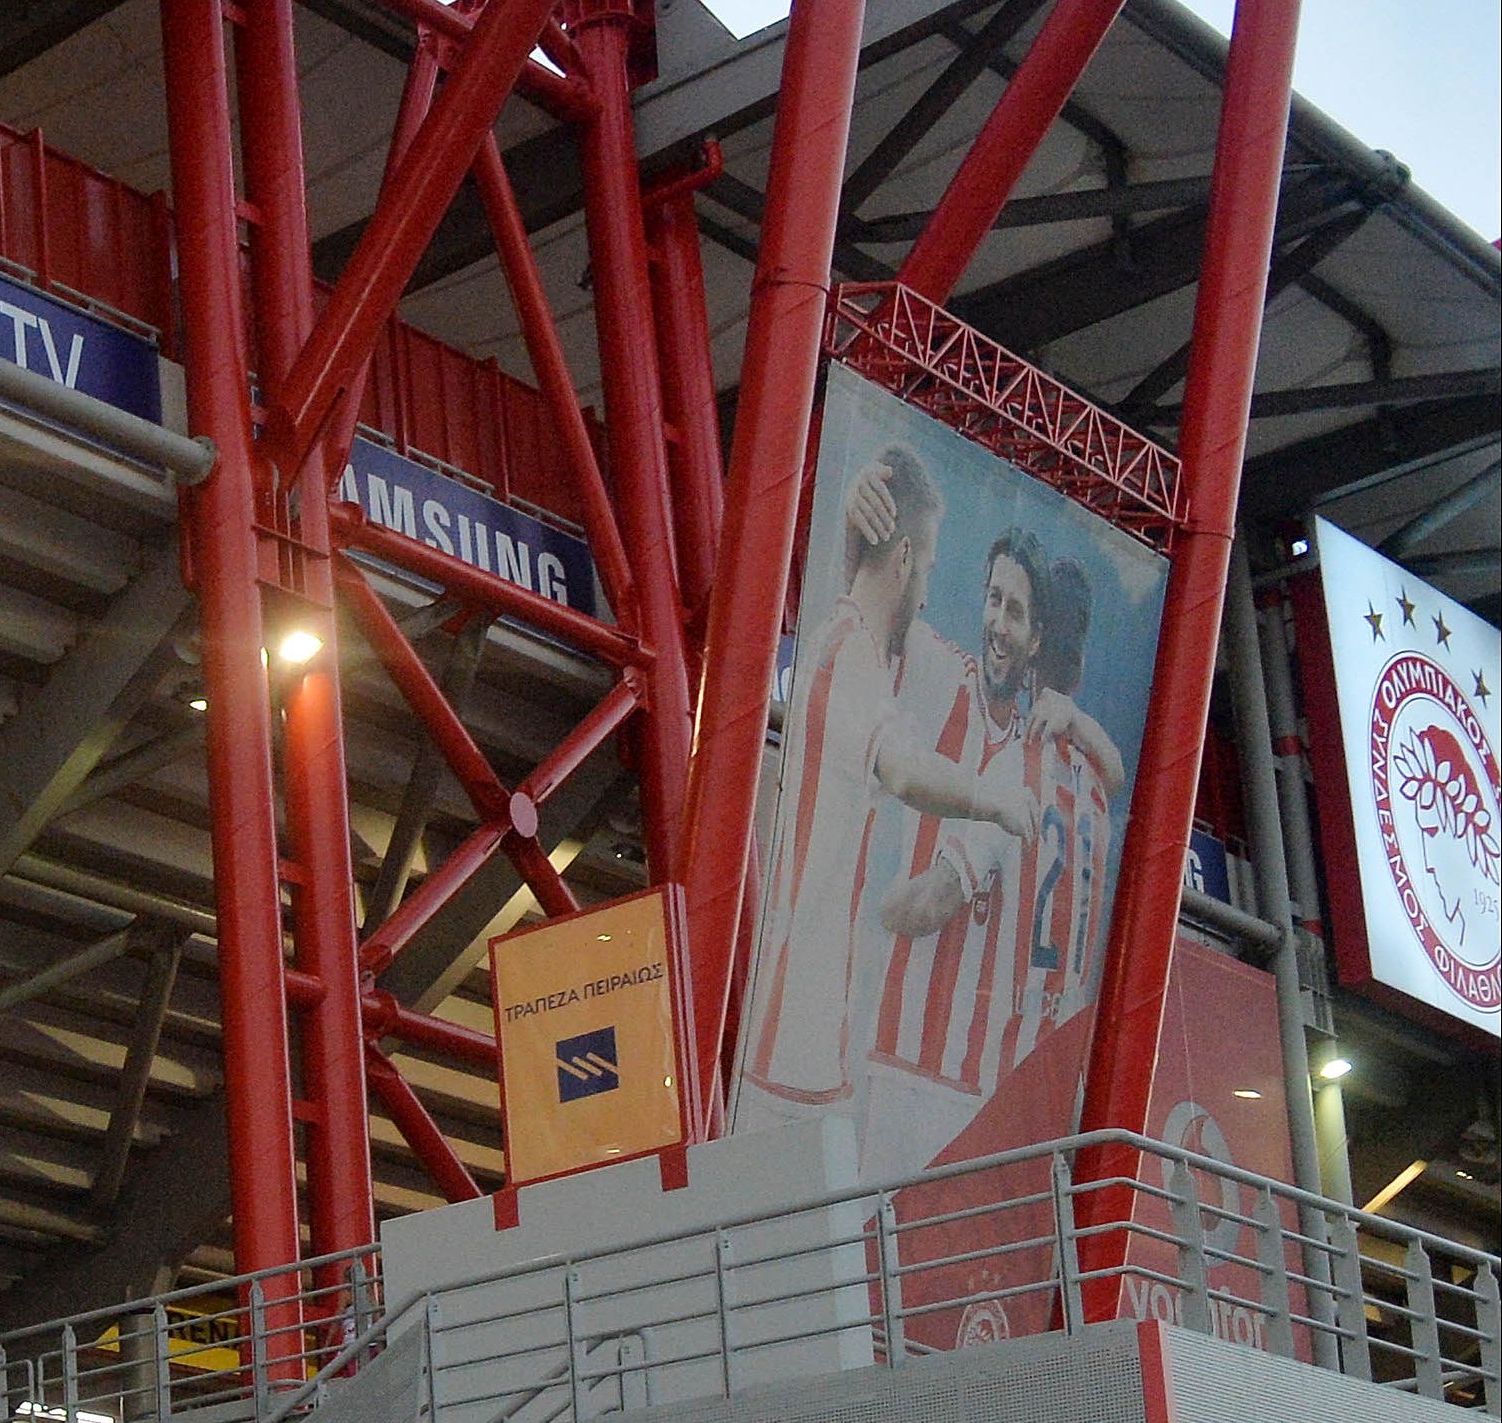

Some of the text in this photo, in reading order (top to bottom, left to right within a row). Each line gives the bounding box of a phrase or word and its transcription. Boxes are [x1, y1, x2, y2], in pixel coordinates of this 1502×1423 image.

[0, 300, 85, 390] TV
[340, 463, 568, 606] AMSUNG
[1381, 661, 1491, 765] ΟΛΥΜΠΙΑΚΟΣ
[1370, 705, 1428, 942] ΣΥΝΔΕΣΜΟΣ
[505, 963, 664, 1022] ΤΡΑΠΕΖΑ ΠΕΙΡΑΙΩΣ
[1434, 945, 1501, 1001] ΦΙΛΑΘΛ
